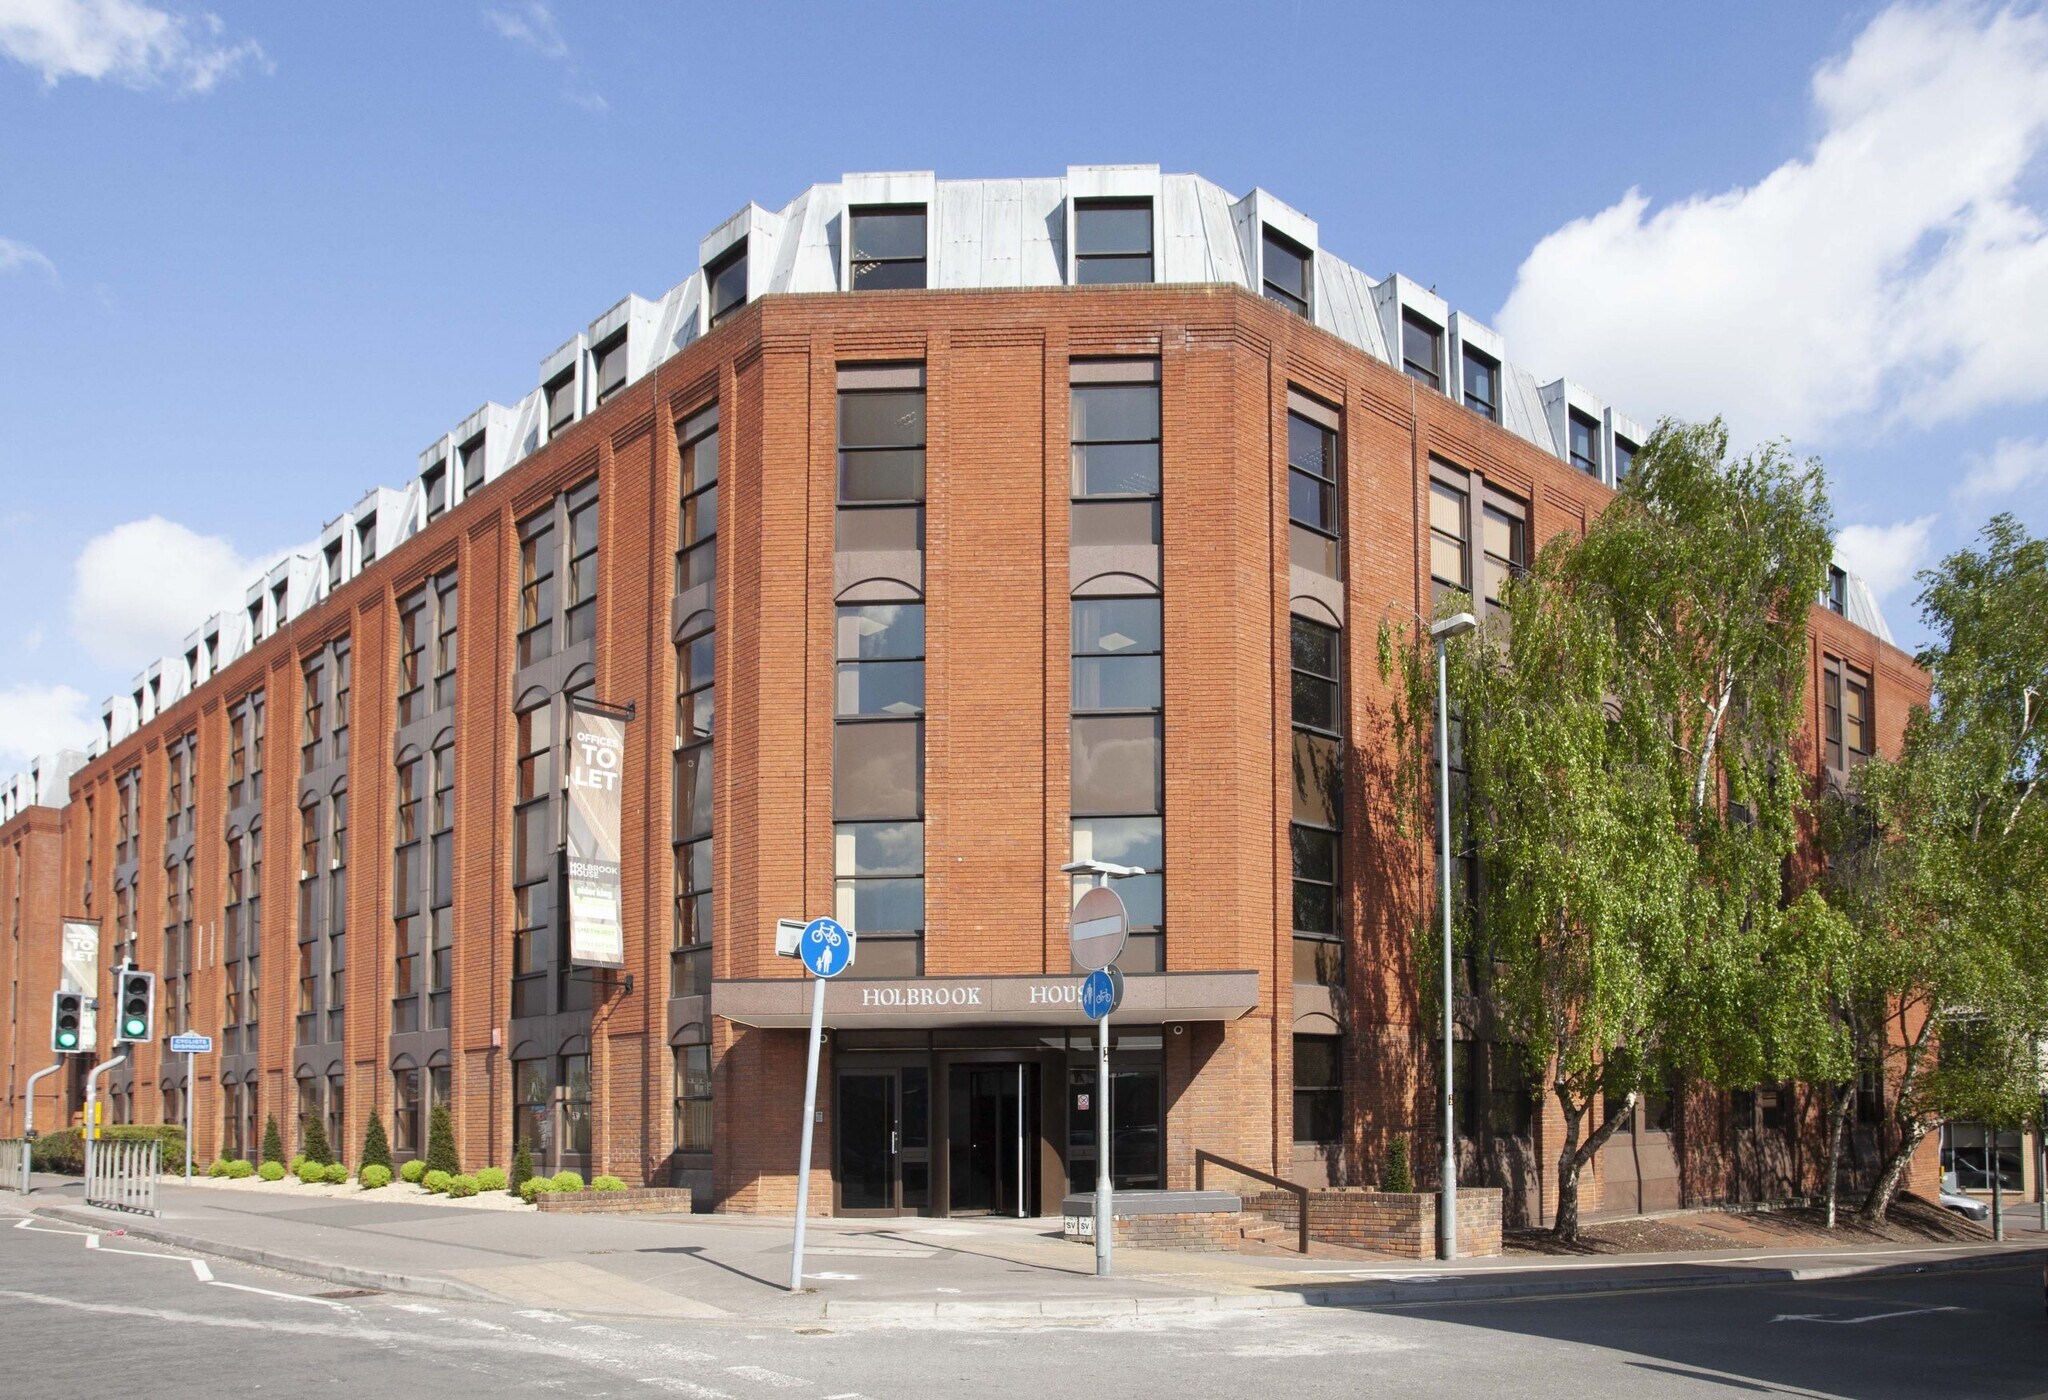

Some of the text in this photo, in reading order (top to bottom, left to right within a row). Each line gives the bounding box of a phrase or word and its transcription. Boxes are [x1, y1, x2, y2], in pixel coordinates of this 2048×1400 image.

[577, 732, 619, 748] OFFICES
[581, 743, 616, 769] TO
[575, 765, 618, 791] LET
[570, 861, 618, 875] HOLBROOK
[570, 869, 599, 879] HOUSE
[70, 939, 95, 951] TO
[862, 985, 1084, 1006] HOLBROOK HOUS
[1066, 1221, 1076, 1229] SV
[1080, 1222, 1090, 1230] SV
